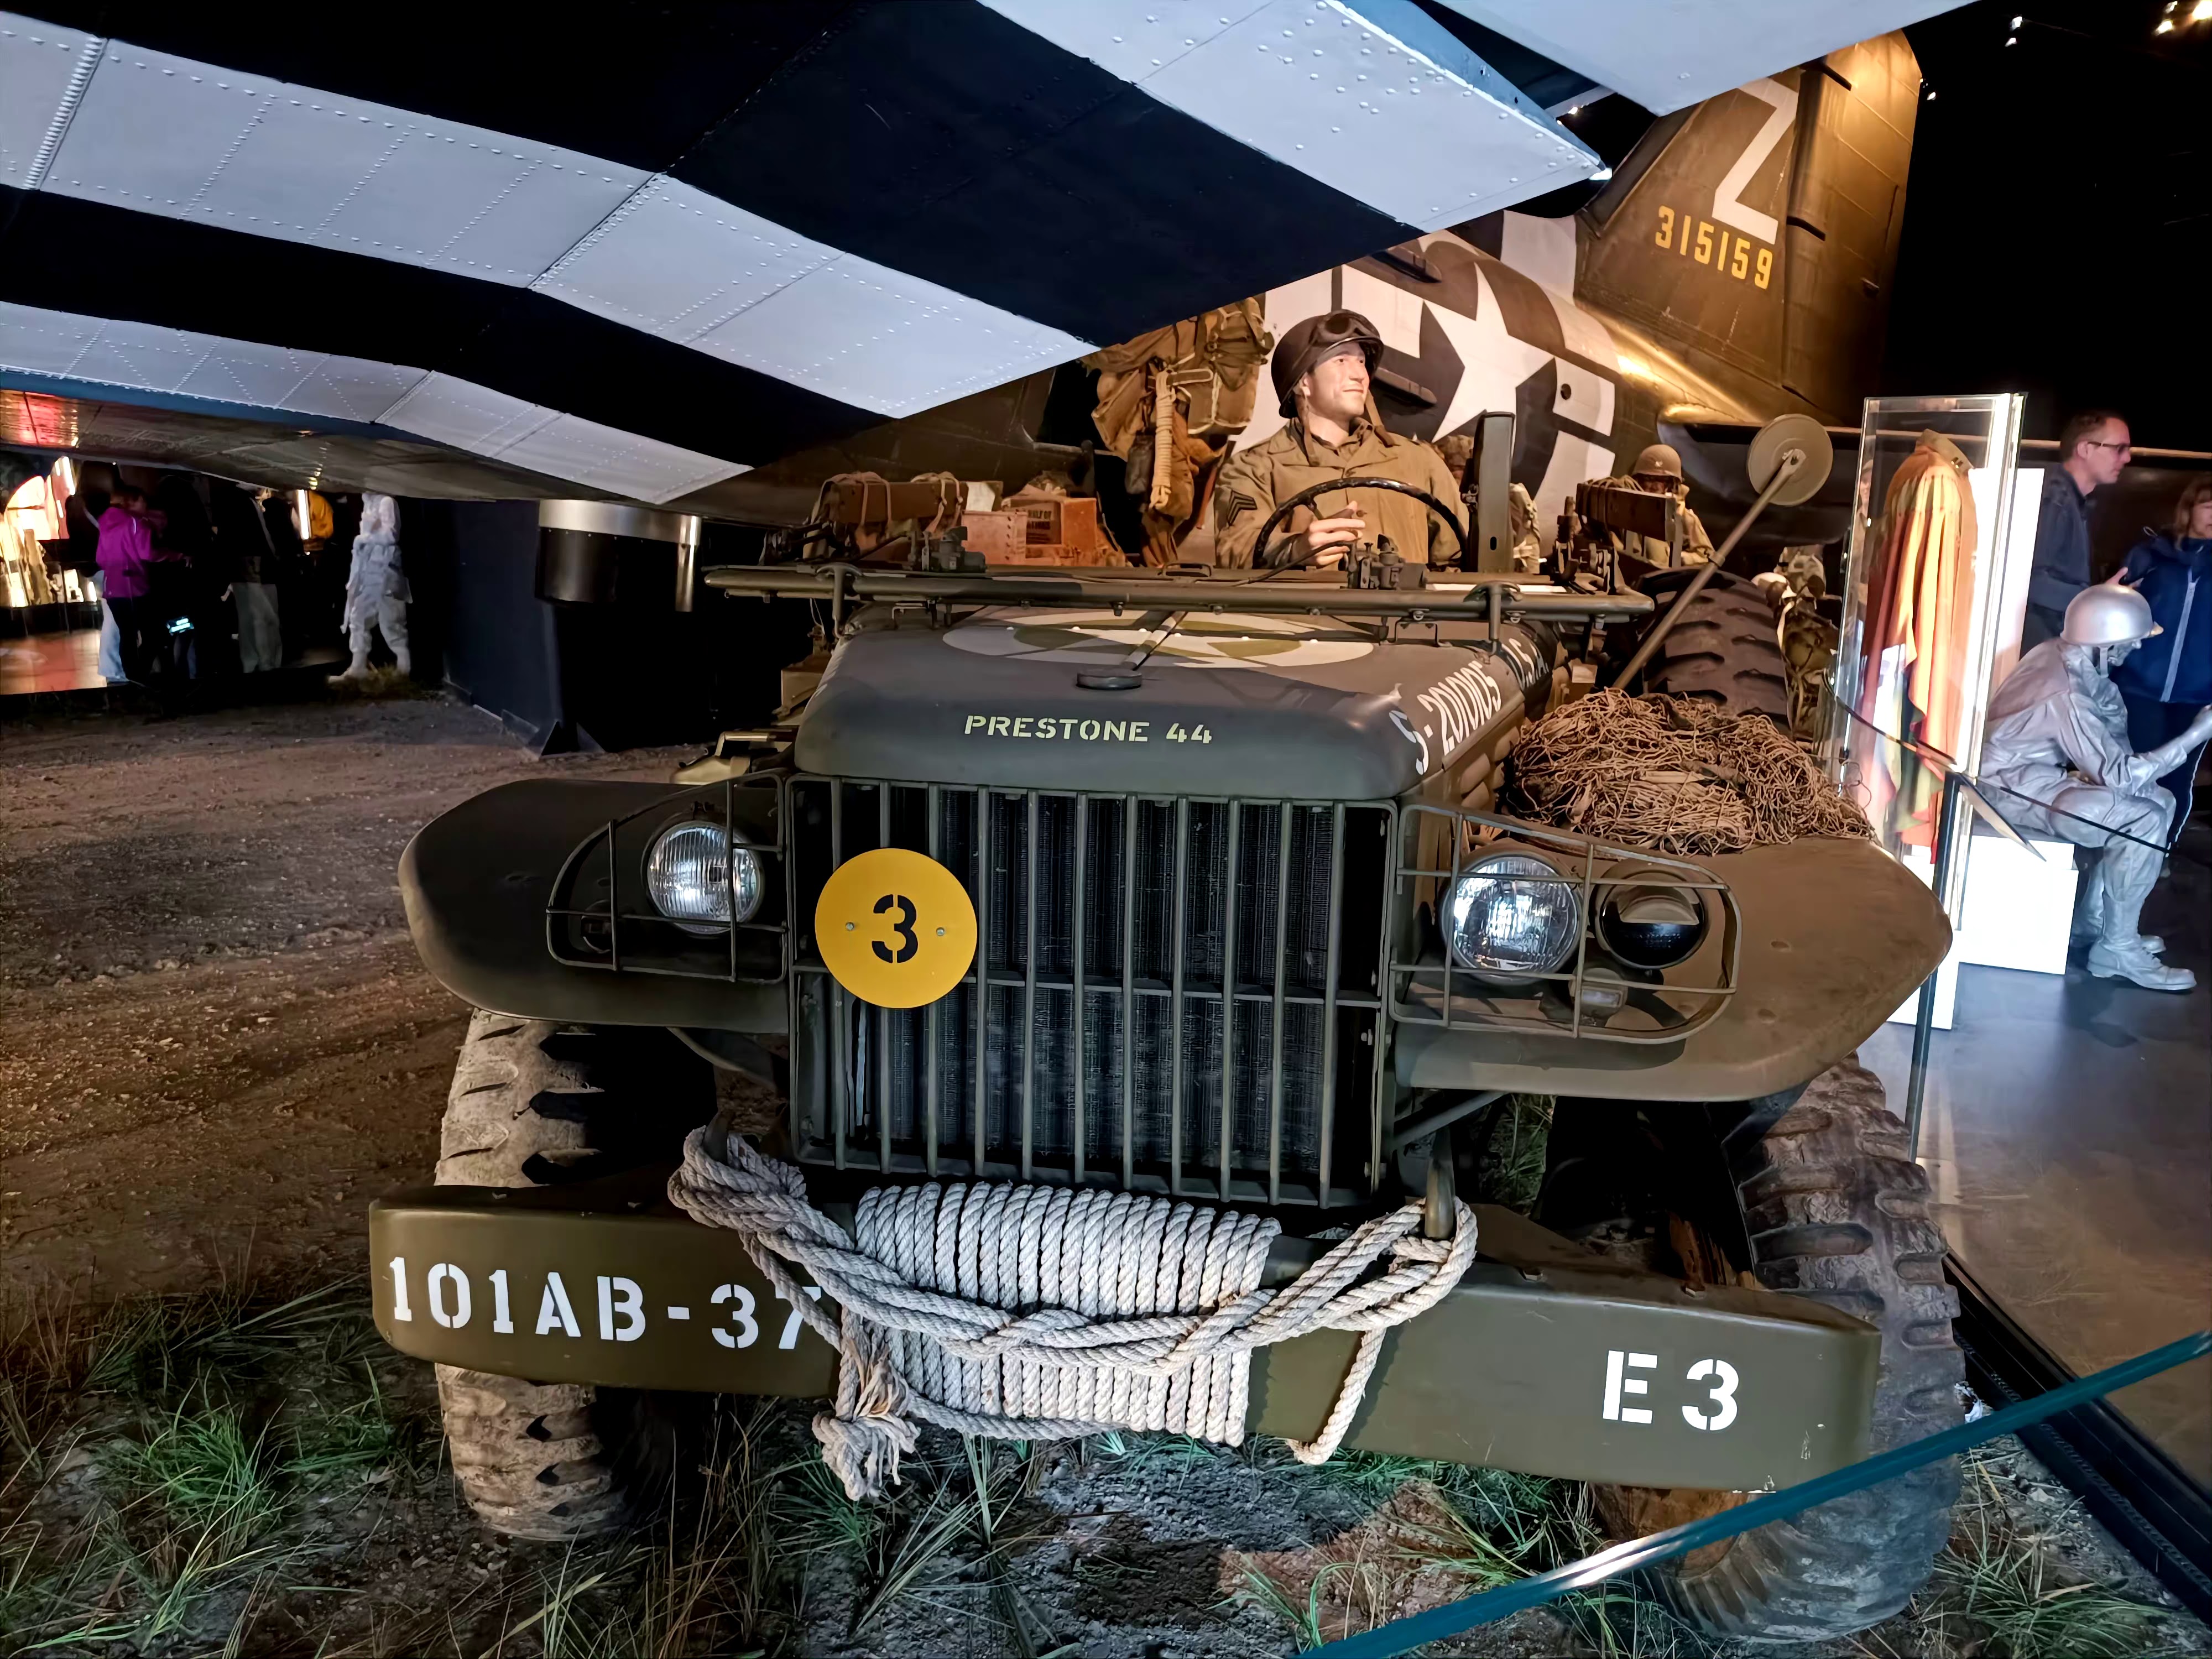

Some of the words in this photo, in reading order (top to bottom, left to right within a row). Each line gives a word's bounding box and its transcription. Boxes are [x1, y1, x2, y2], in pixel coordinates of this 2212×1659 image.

[1712, 77, 1798, 244] Z
[1656, 205, 1773, 289] 315159
[964, 715, 1150, 742] PRESTONE
[1166, 723, 1212, 743] 44
[872, 894, 918, 963] 3
